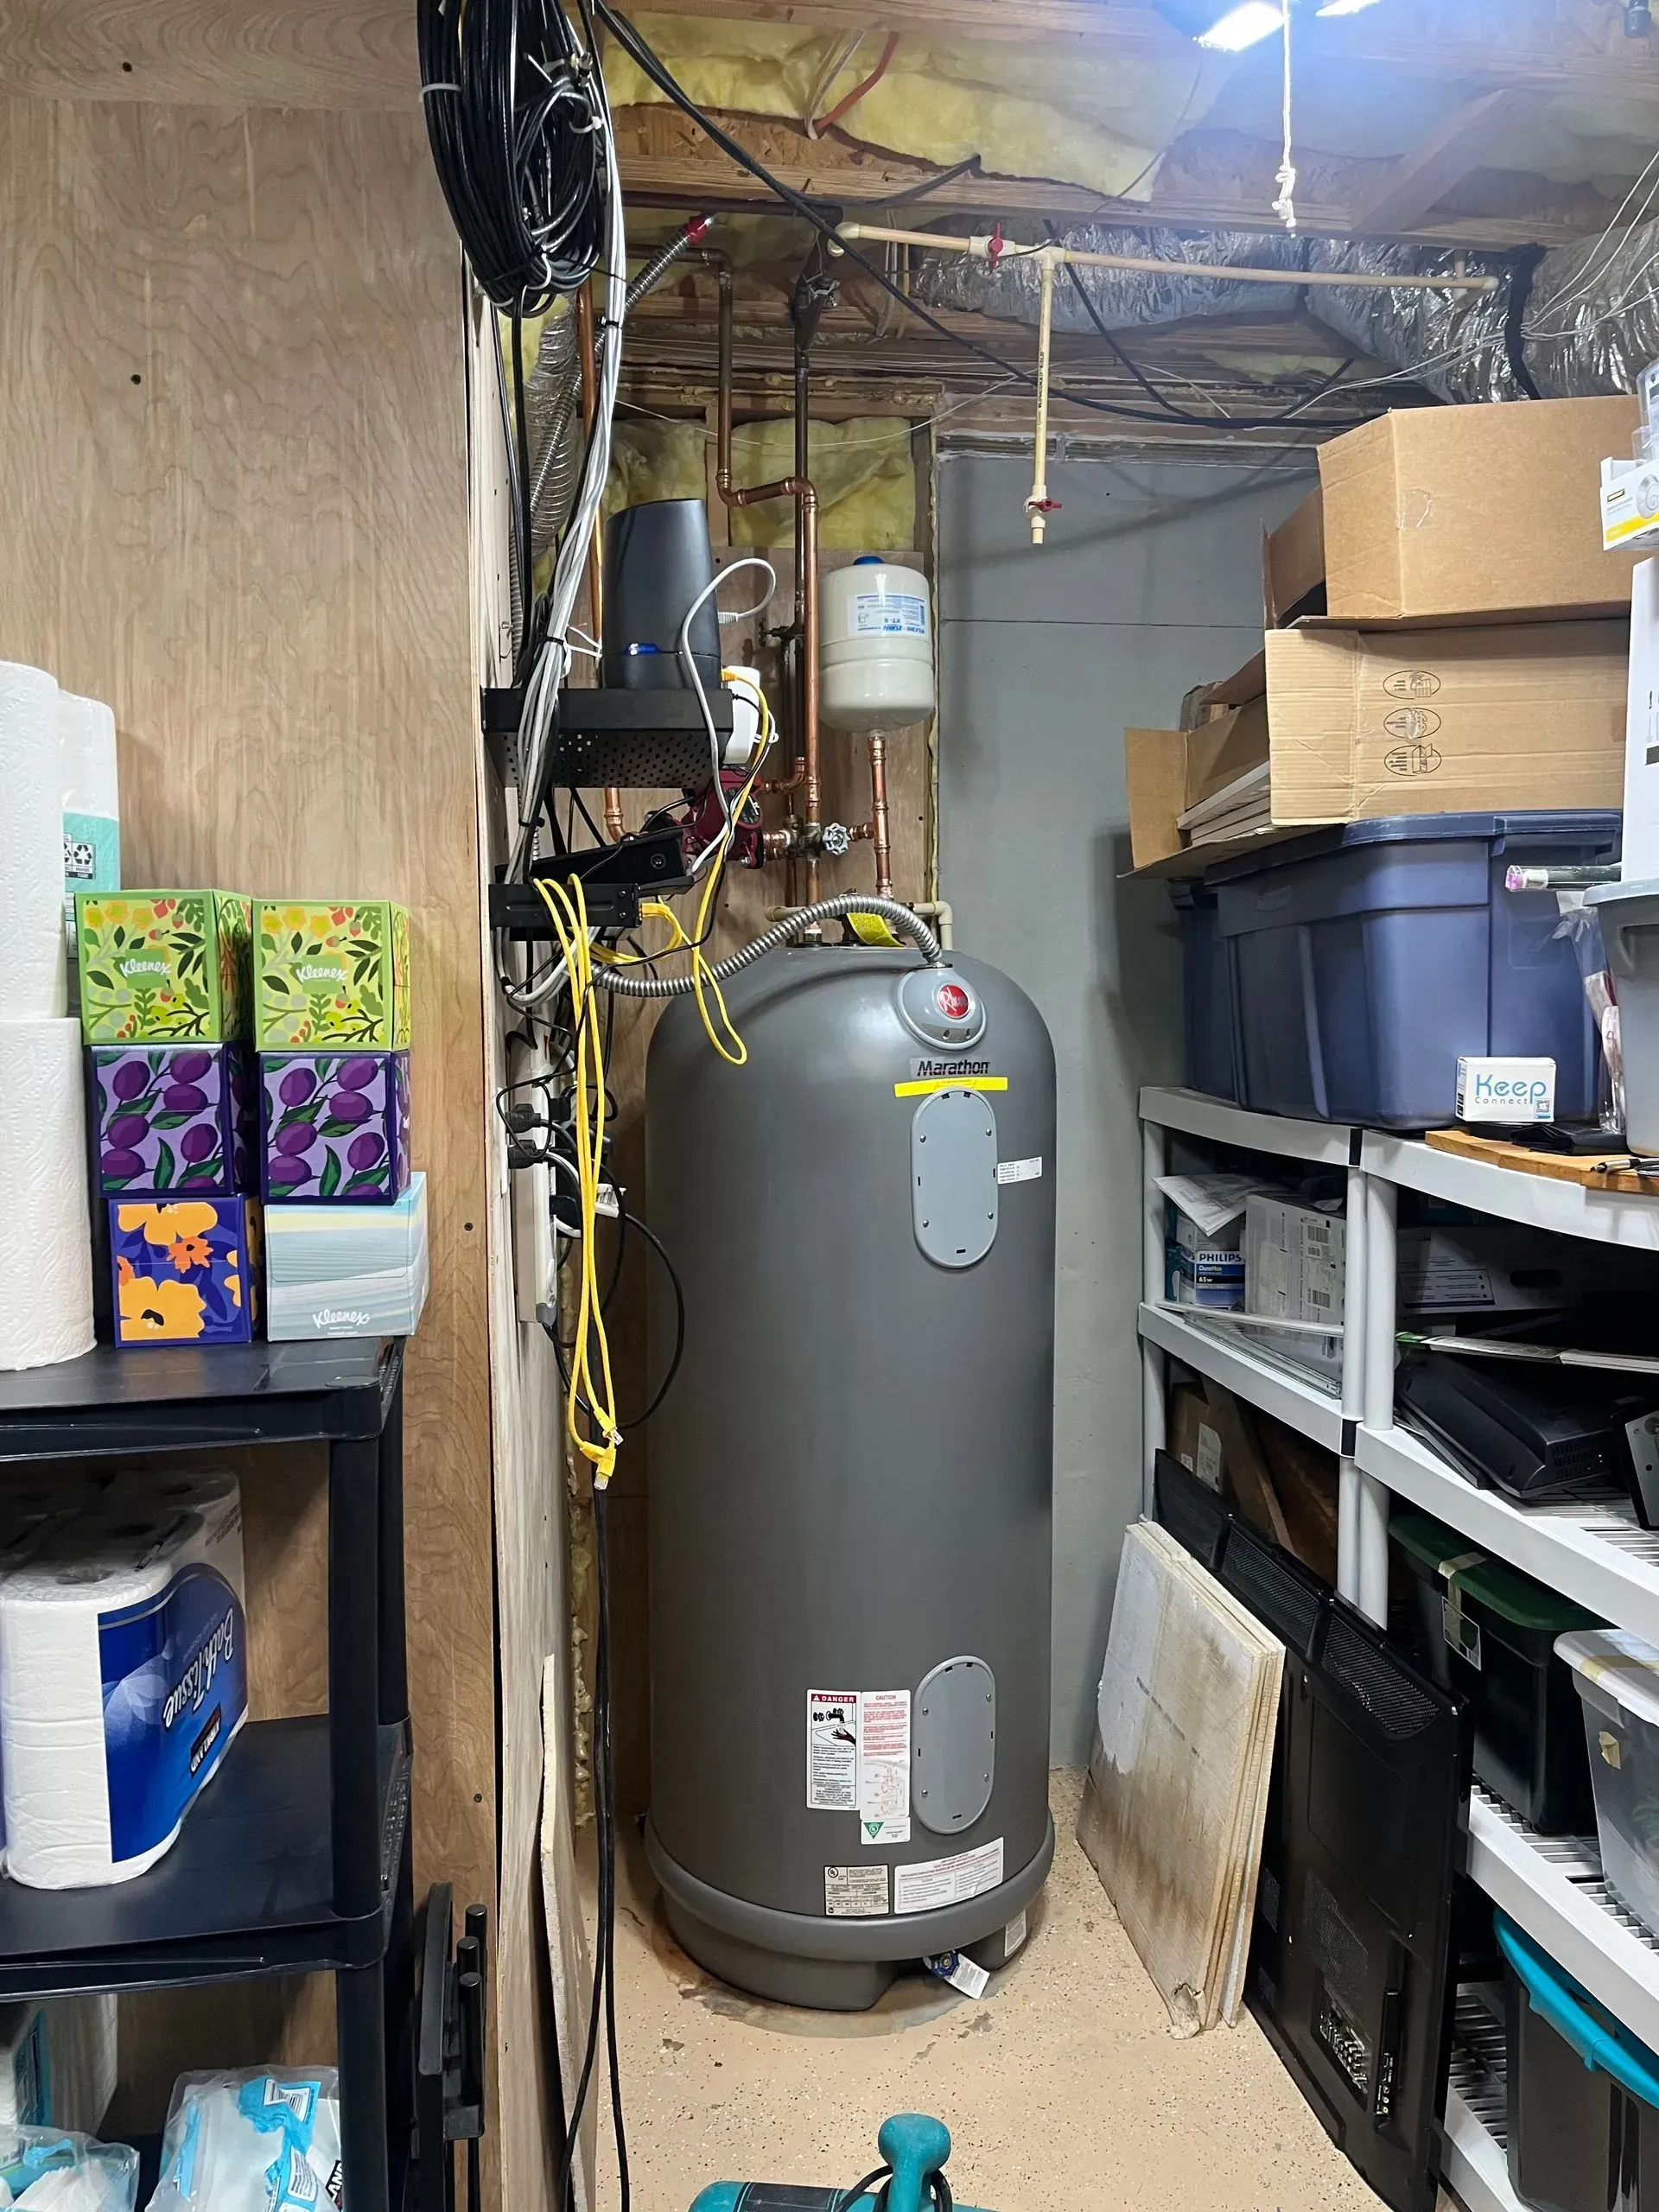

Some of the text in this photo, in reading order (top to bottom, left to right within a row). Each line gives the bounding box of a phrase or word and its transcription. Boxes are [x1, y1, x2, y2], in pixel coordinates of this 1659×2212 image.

[119, 957, 172, 978] Kleenex
[296, 962, 349, 982] Kleenex
[917, 1059, 990, 1077] Marathon
[1476, 1074, 1547, 1105] Keep
[1474, 1096, 1528, 1104] Connect
[1199, 1253, 1242, 1262] PHILIPS
[312, 1308, 371, 1329] Kleenex
[202, 1607, 233, 1691] Bath
[162, 1651, 205, 1728] Tissue
[821, 1694, 855, 1703] DANGER
